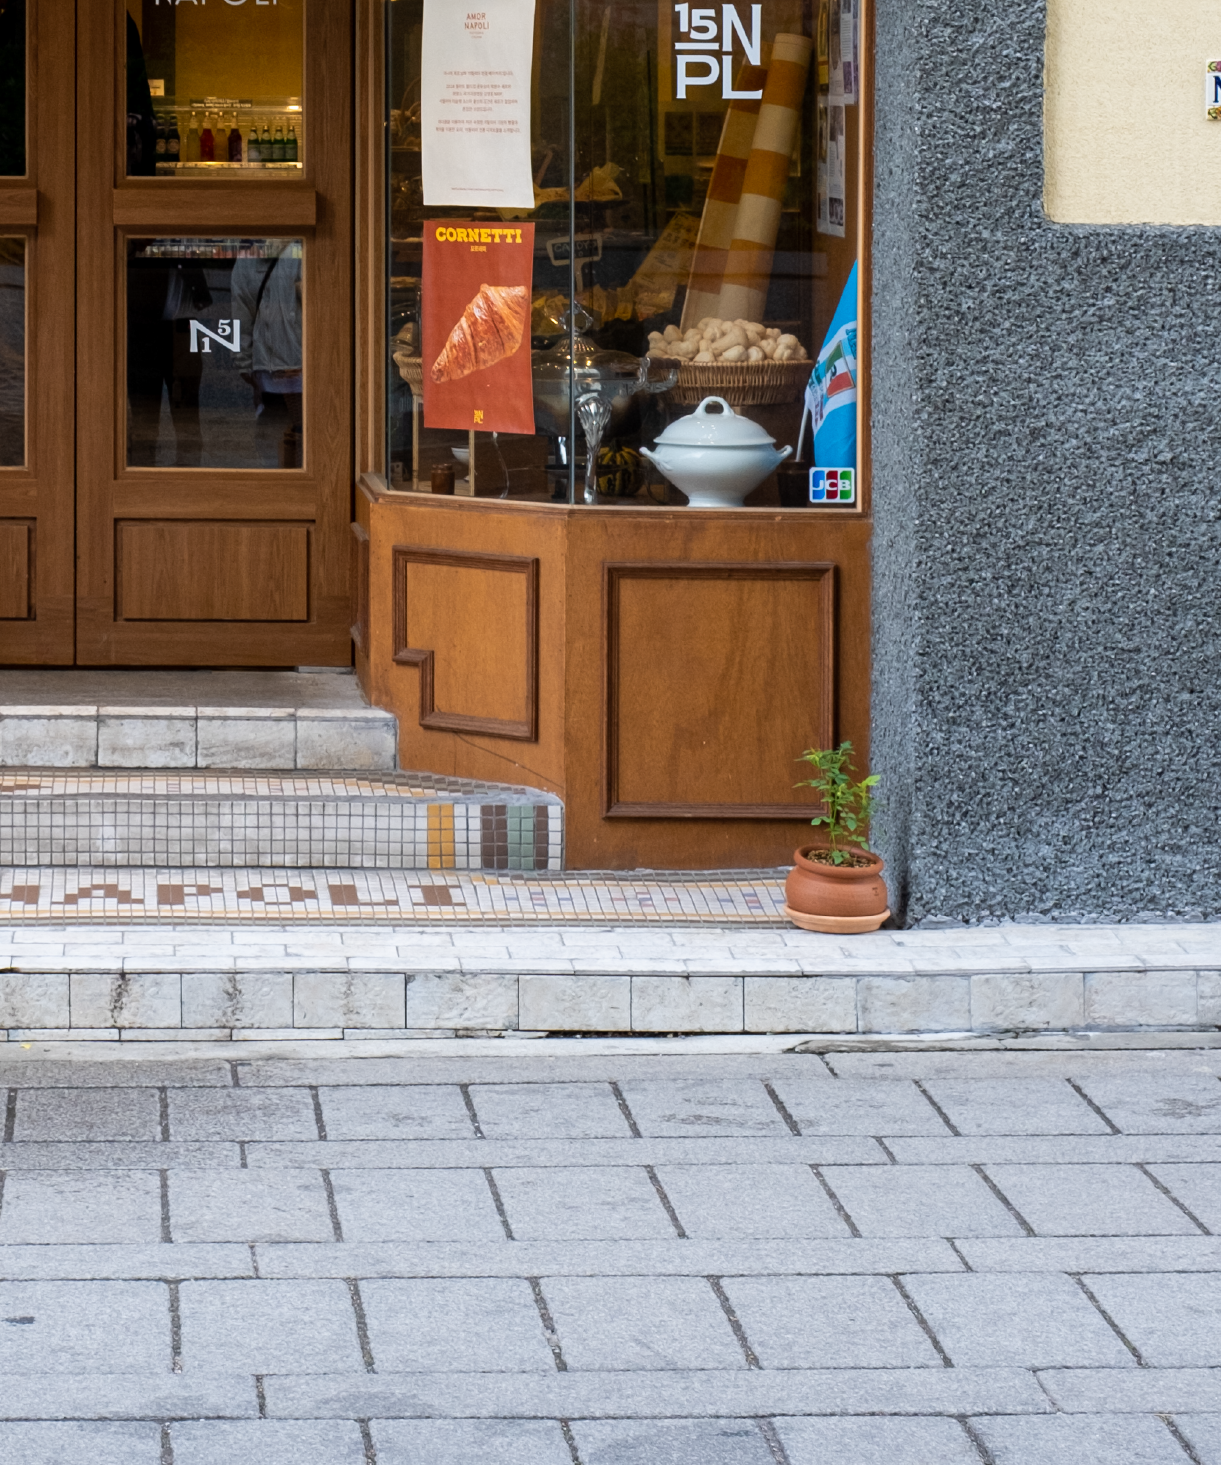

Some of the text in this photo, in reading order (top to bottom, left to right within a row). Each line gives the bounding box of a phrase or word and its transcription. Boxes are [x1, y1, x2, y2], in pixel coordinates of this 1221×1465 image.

[466, 12, 486, 21] AMOR
[464, 21, 490, 30] NAPOLI
[435, 226, 522, 244] CORNETTI
[812, 478, 852, 491] JCB
